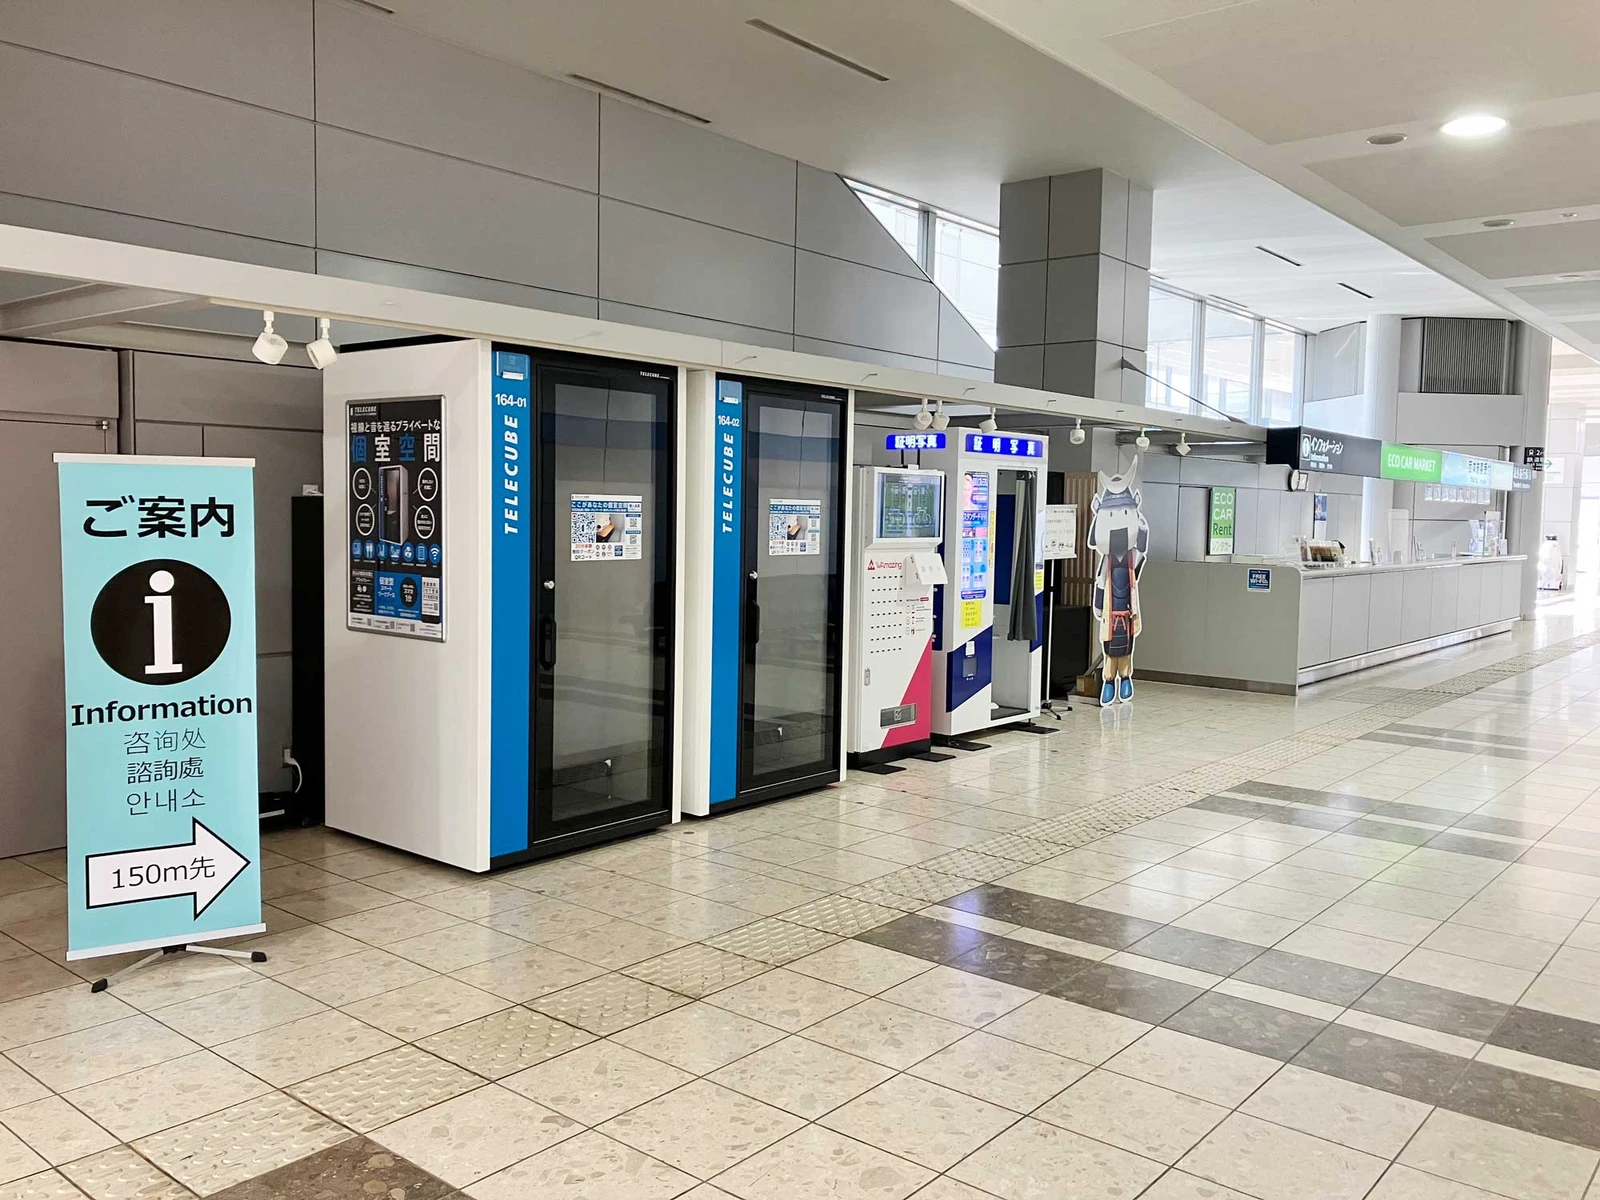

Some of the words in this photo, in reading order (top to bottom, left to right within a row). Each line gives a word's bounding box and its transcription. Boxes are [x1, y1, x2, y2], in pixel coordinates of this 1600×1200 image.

[495, 393, 527, 408] 164-01
[717, 414, 740, 427] 164-02
[351, 432, 440, 463] 個室空間
[894, 434, 937, 448] 証明写真
[973, 435, 1035, 456] 証明写真
[504, 414, 519, 534] TELECUBE
[1387, 454, 1400, 468] ECO
[1400, 457, 1413, 470] CAR
[1413, 458, 1437, 473] MARKET
[723, 432, 734, 533] TELECUBE
[1214, 492, 1234, 505] ECO
[83, 495, 235, 539] ご案内
[1213, 508, 1233, 520] CAR
[1212, 522, 1232, 536] Rent
[71, 694, 253, 727] Information
[123, 727, 207, 755] 咨询处
[127, 757, 204, 785] 諮詢處
[126, 787, 206, 816] 안내소
[112, 855, 216, 889] 150m先
